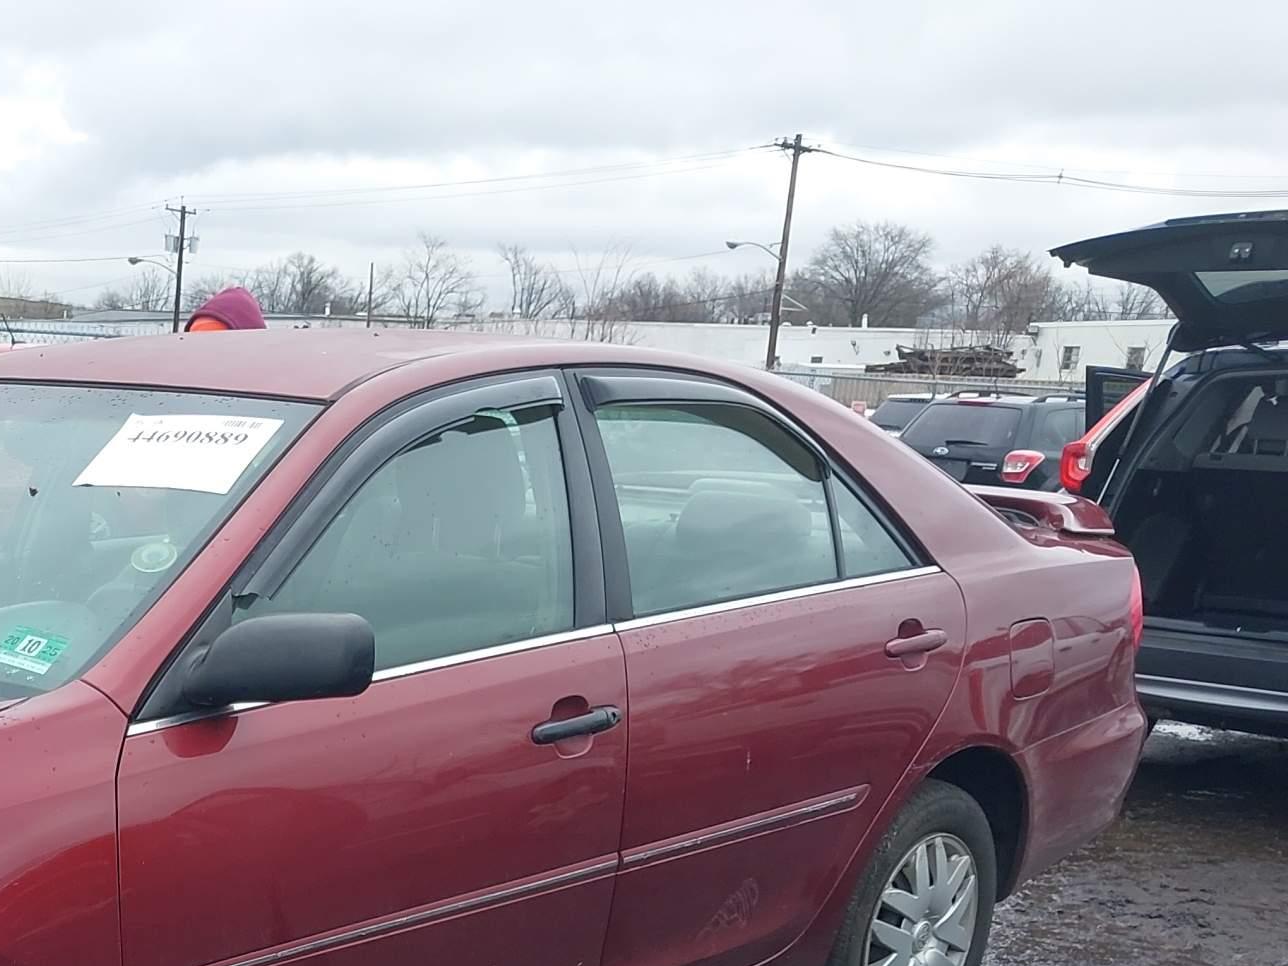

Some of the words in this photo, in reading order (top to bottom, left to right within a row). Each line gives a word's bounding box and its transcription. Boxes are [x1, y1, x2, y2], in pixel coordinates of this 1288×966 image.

[127, 430, 249, 446] 44690889
[4, 635, 21, 646] 20
[19, 638, 42, 654] 10
